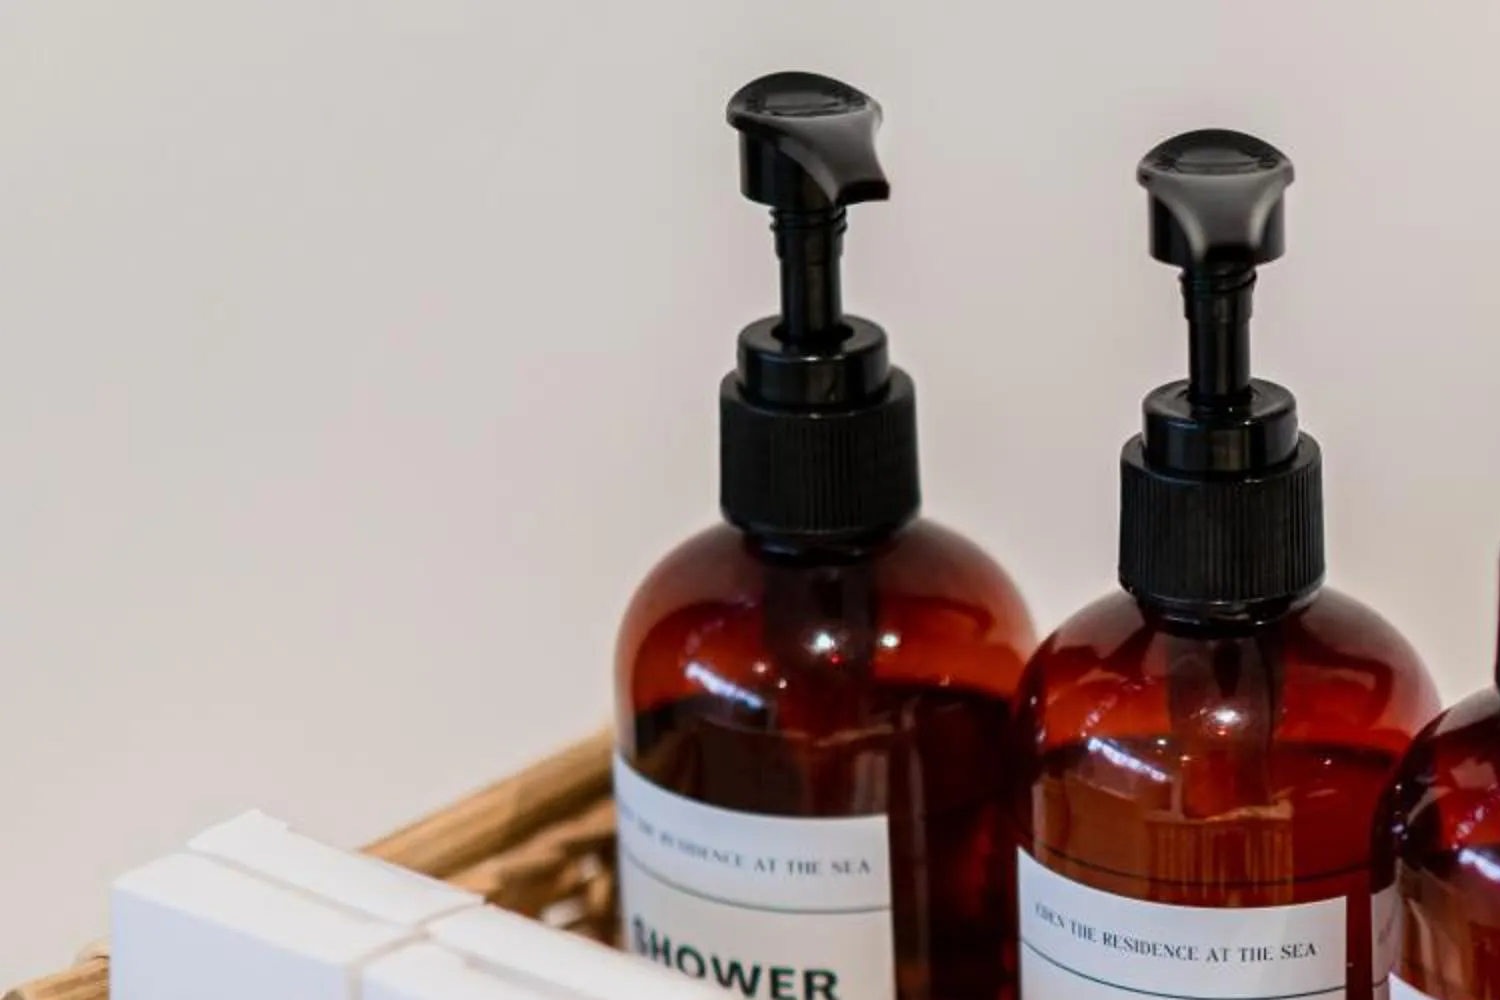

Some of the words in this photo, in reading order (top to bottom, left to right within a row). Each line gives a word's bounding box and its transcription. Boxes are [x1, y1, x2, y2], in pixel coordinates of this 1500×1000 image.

[754, 857, 777, 874] AT
[786, 859, 822, 876] THE
[831, 859, 871, 875] SEA
[1070, 920, 1097, 942] THE
[1102, 931, 1199, 962] RESIDENCE
[1205, 947, 1230, 962] AT
[1239, 947, 1274, 962] THE
[1280, 942, 1320, 960] SEA
